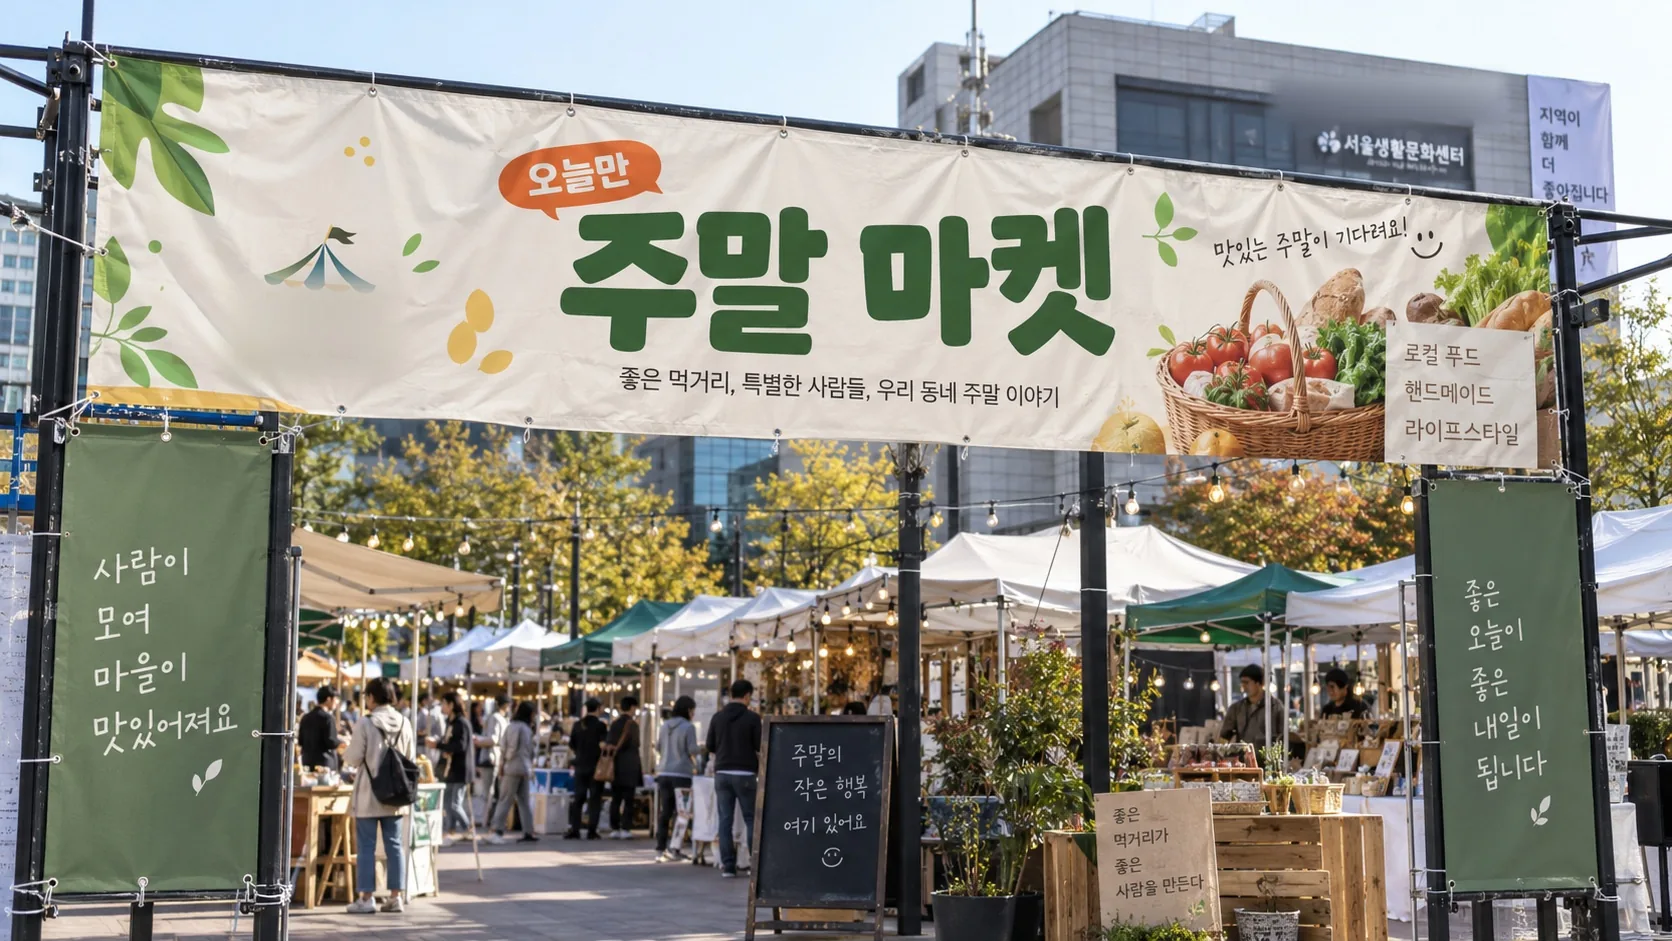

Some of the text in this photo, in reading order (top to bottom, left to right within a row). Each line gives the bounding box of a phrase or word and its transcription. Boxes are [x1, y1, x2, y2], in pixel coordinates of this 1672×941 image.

[1539, 107, 1581, 128] 지역이
[1344, 134, 1464, 167] 서울생활문화센터
[1541, 131, 1569, 151] 함께
[527, 152, 630, 198] 오늘만
[1541, 156, 1555, 174] 더
[1542, 181, 1608, 203] 좋아집니다
[1213, 216, 1407, 268] 맛있는 주말이 기다려요!
[560, 205, 1116, 357] 주말 마켓
[1404, 343, 1481, 368] 로컬 푸드
[619, 366, 1059, 409] 좋은 먹거리, 특별한 사람들, 우리 동네 주말 이야기
[1405, 380, 1494, 405] 핸드메이드
[1405, 419, 1518, 447] 라이프스타일
[93, 546, 188, 586] 사람이
[1464, 579, 1500, 613] 좋은
[94, 603, 150, 641] 모여
[1468, 618, 1523, 651] 오늘이
[94, 651, 186, 695] 마을이
[1470, 666, 1508, 703] 좋은
[93, 703, 238, 757] 맛있어져요
[1474, 705, 1541, 741] 내일이
[792, 743, 841, 768] 주말의
[1477, 750, 1548, 792] 됩니다
[794, 775, 868, 801] 작은 행복
[783, 813, 867, 836] 여기 있어요
[1113, 806, 1140, 825] 좋은
[1113, 827, 1169, 848] 먹거리가
[1114, 856, 1142, 876] 좋은
[1115, 873, 1204, 900] 사람을 만든다
